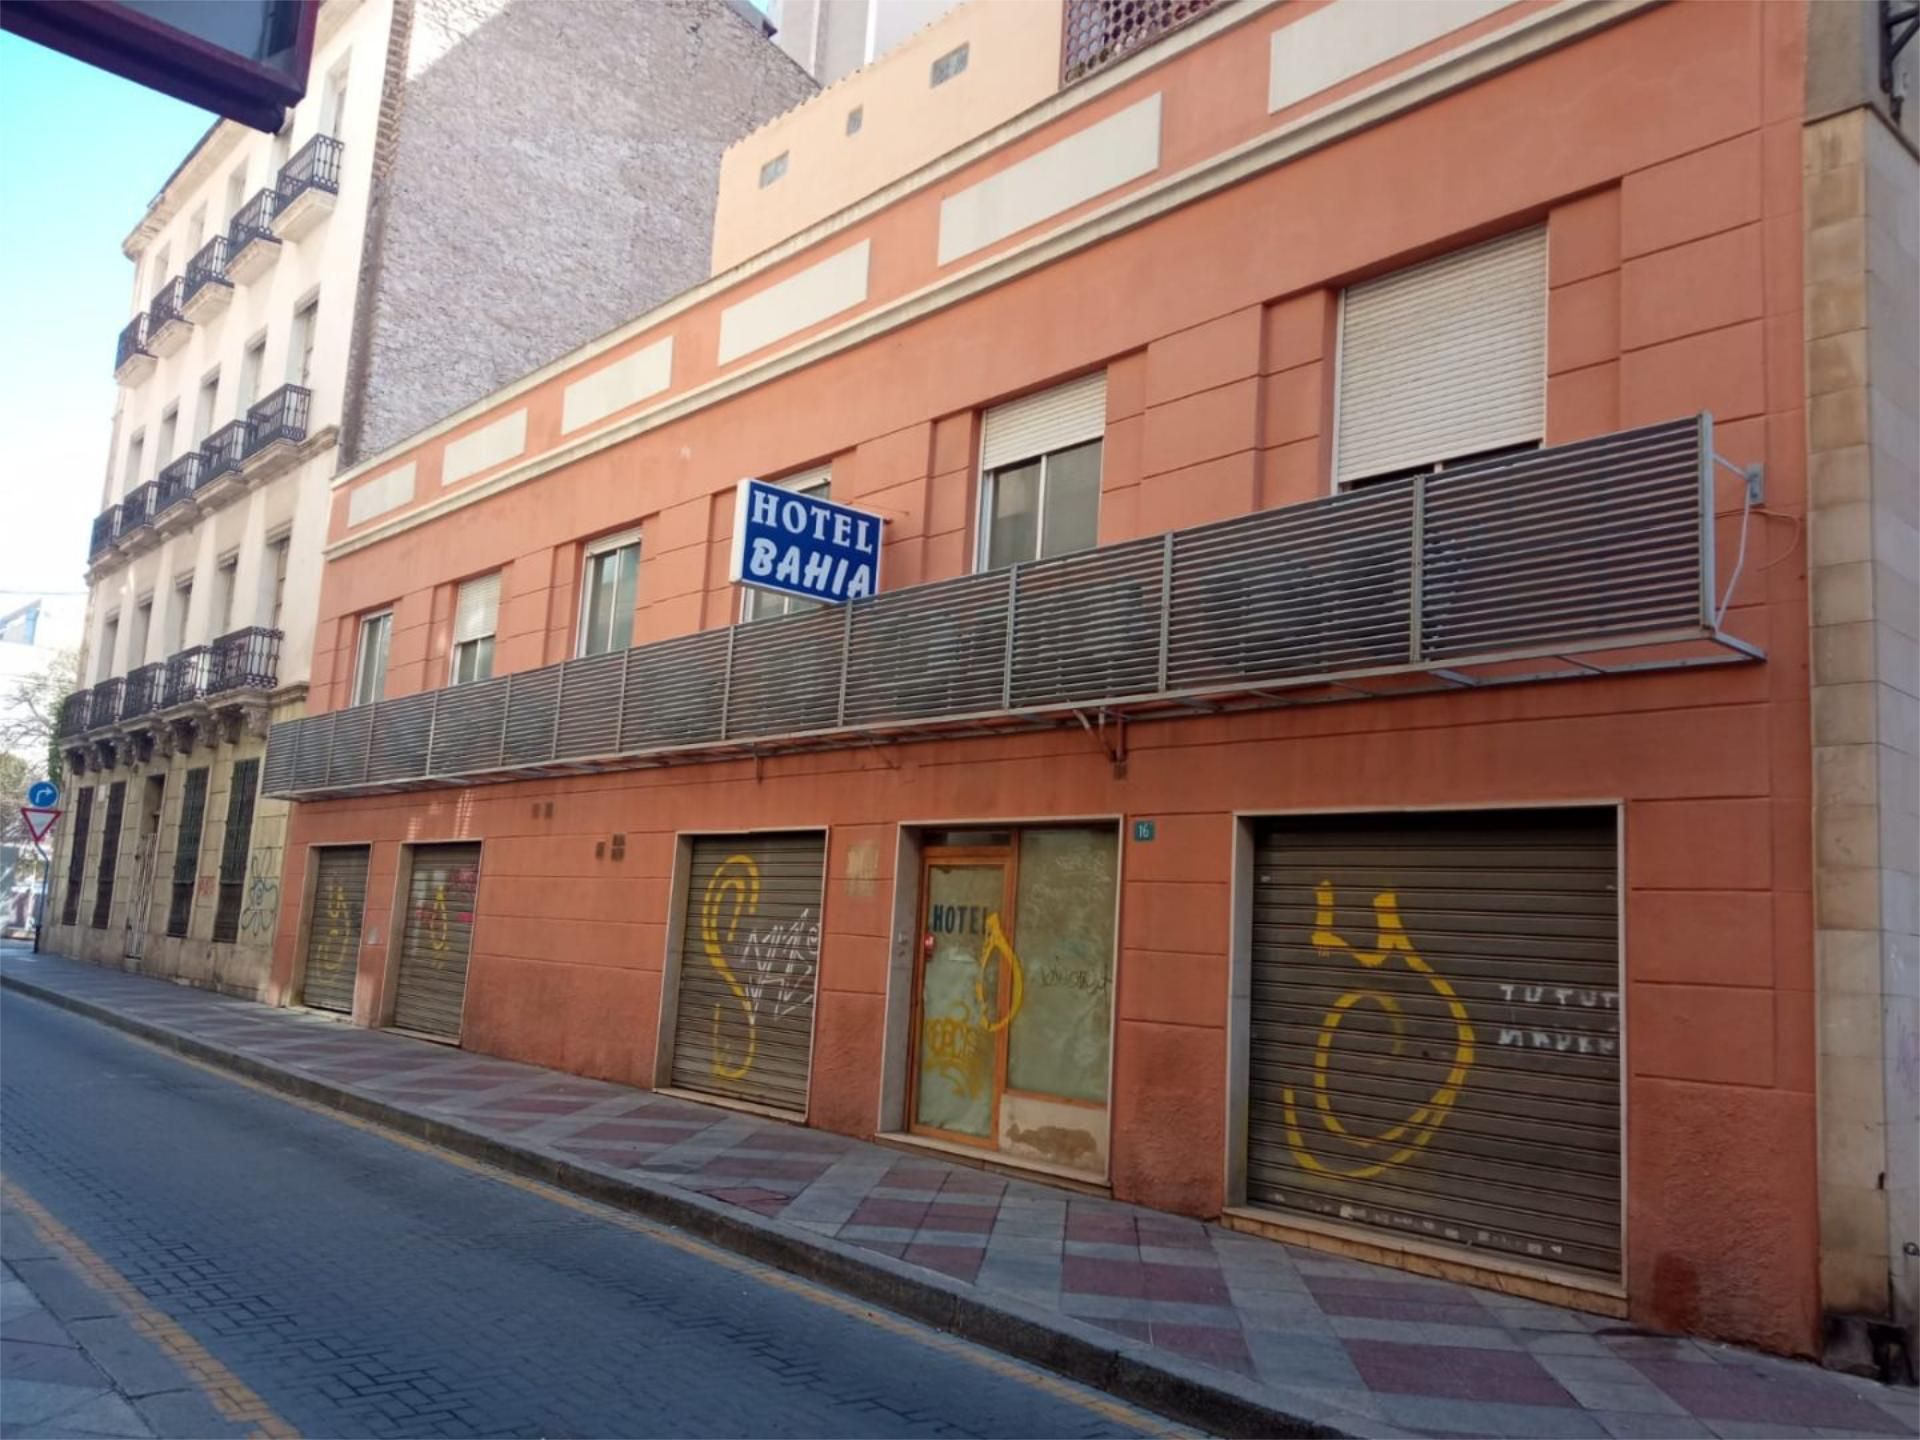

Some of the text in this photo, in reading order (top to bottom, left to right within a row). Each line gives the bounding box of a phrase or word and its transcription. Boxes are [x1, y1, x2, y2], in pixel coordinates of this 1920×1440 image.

[752, 490, 873, 555] HOTEL
[750, 537, 871, 598] BAHIA
[1138, 823, 1150, 838] 16
